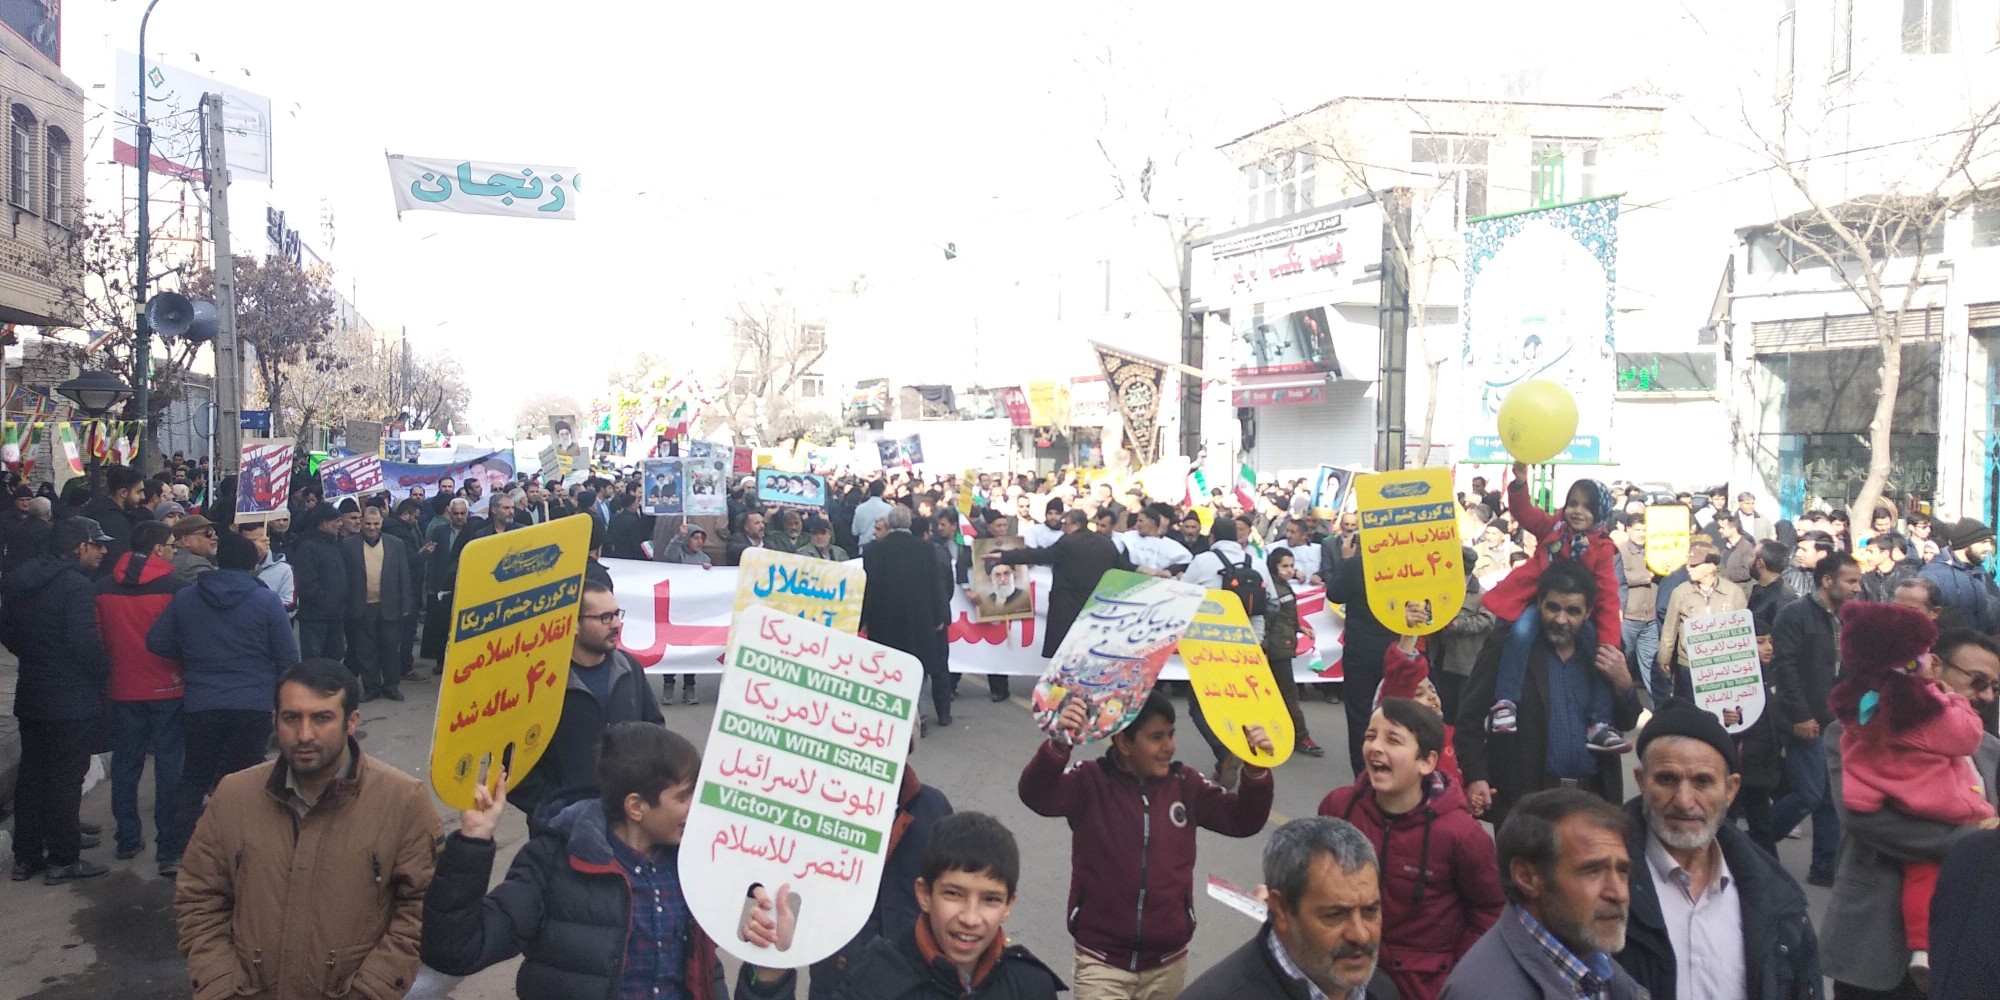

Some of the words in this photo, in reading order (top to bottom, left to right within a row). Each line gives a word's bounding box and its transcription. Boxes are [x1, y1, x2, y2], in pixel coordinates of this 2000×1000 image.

[411, 161, 566, 212] زنجان
[1363, 509, 1393, 526] آمریکا
[1395, 508, 1416, 524] چشم
[1417, 505, 1442, 521] کوری
[1442, 506, 1454, 517] به
[1368, 531, 1414, 554] اسلامی
[1416, 526, 1455, 547] انقلاب
[1374, 567, 1394, 582] شد
[1397, 564, 1425, 578] ساله
[1427, 551, 1453, 576] ۴۰
[566, 581, 579, 598] به
[753, 563, 847, 602] استقلال
[502, 597, 532, 621] چشم
[532, 583, 567, 613] کوری
[459, 599, 502, 632] آمریکا
[1690, 618, 1716, 632] امریکا
[1719, 620, 1726, 629] بر
[1728, 612, 1746, 626] مرگ
[522, 614, 573, 658] انقلاب
[760, 615, 829, 658] امریکا
[1727, 637, 1750, 650] الموت
[453, 631, 521, 685] اسلامی
[829, 652, 853, 675] بر
[859, 650, 903, 685] مرگ
[1189, 648, 1227, 666] اسلامی
[1230, 650, 1262, 668] انقلاب
[1732, 661, 1755, 674] الموت
[526, 660, 557, 704] ۴۰
[741, 649, 800, 683] DOWN
[806, 667, 852, 699] WITH
[857, 683, 904, 716] U.S.A
[1204, 685, 1222, 698] شد
[1224, 684, 1249, 699] ساله
[1245, 675, 1272, 701] ۴۰
[481, 688, 520, 718] ساله
[744, 678, 829, 726] لامریکا
[450, 701, 479, 733] شد
[831, 711, 894, 748] الموت
[723, 713, 781, 745] DOWN
[784, 733, 829, 760] WITH
[832, 747, 891, 780] ISRAEL
[719, 748, 817, 794] لاسرائیل
[820, 778, 886, 816] الموت
[718, 786, 789, 825] Victory
[792, 810, 812, 830] to
[816, 813, 868, 846] Islam
[711, 823, 797, 863] للاسلام
